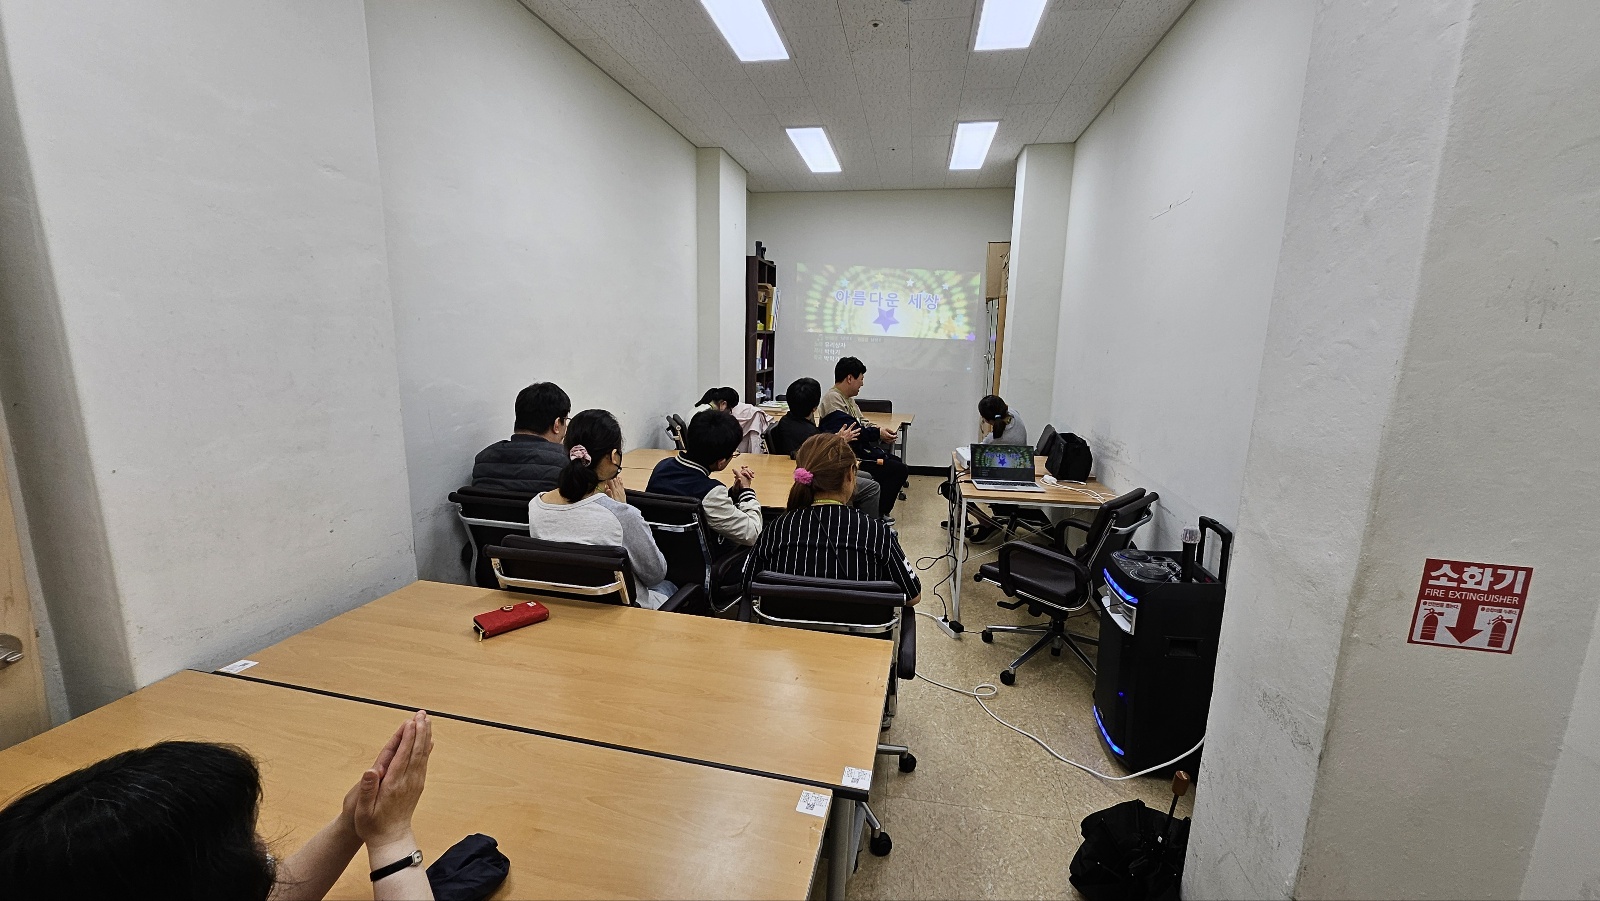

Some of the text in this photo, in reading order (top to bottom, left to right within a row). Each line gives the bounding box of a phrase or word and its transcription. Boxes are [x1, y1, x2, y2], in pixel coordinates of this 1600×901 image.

[835, 289, 940, 310] 아름다운 세상
[1428, 563, 1526, 594] 소화기
[1424, 588, 1519, 605] FIRE EXTINGUISHER
